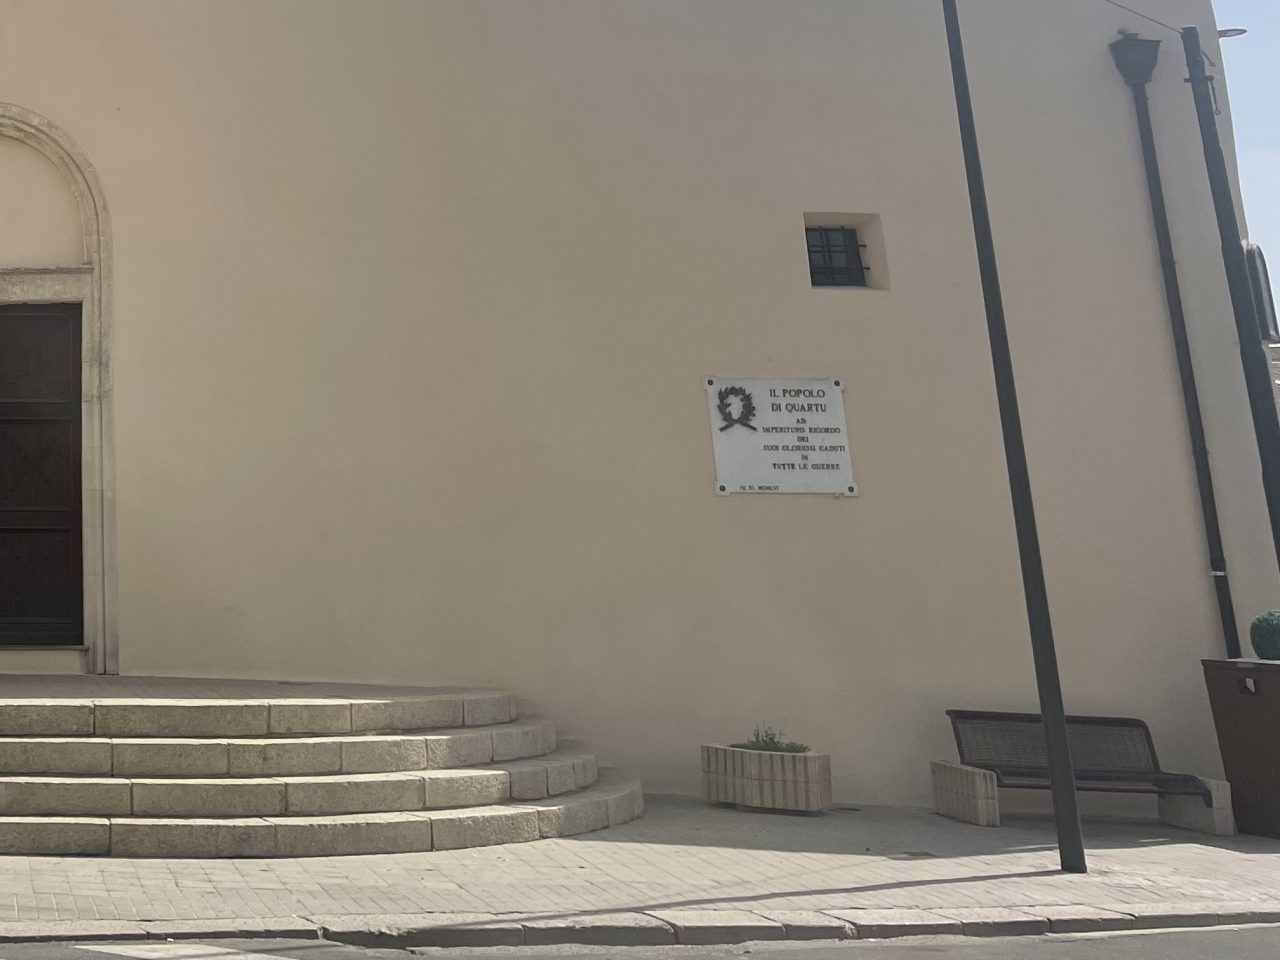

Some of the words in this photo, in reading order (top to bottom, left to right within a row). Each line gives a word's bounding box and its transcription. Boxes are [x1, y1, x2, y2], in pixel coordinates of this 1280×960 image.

[769, 389, 780, 398] IL
[782, 389, 826, 398] POPOLO
[771, 403, 782, 412] DI
[785, 403, 827, 413] QUARTU
